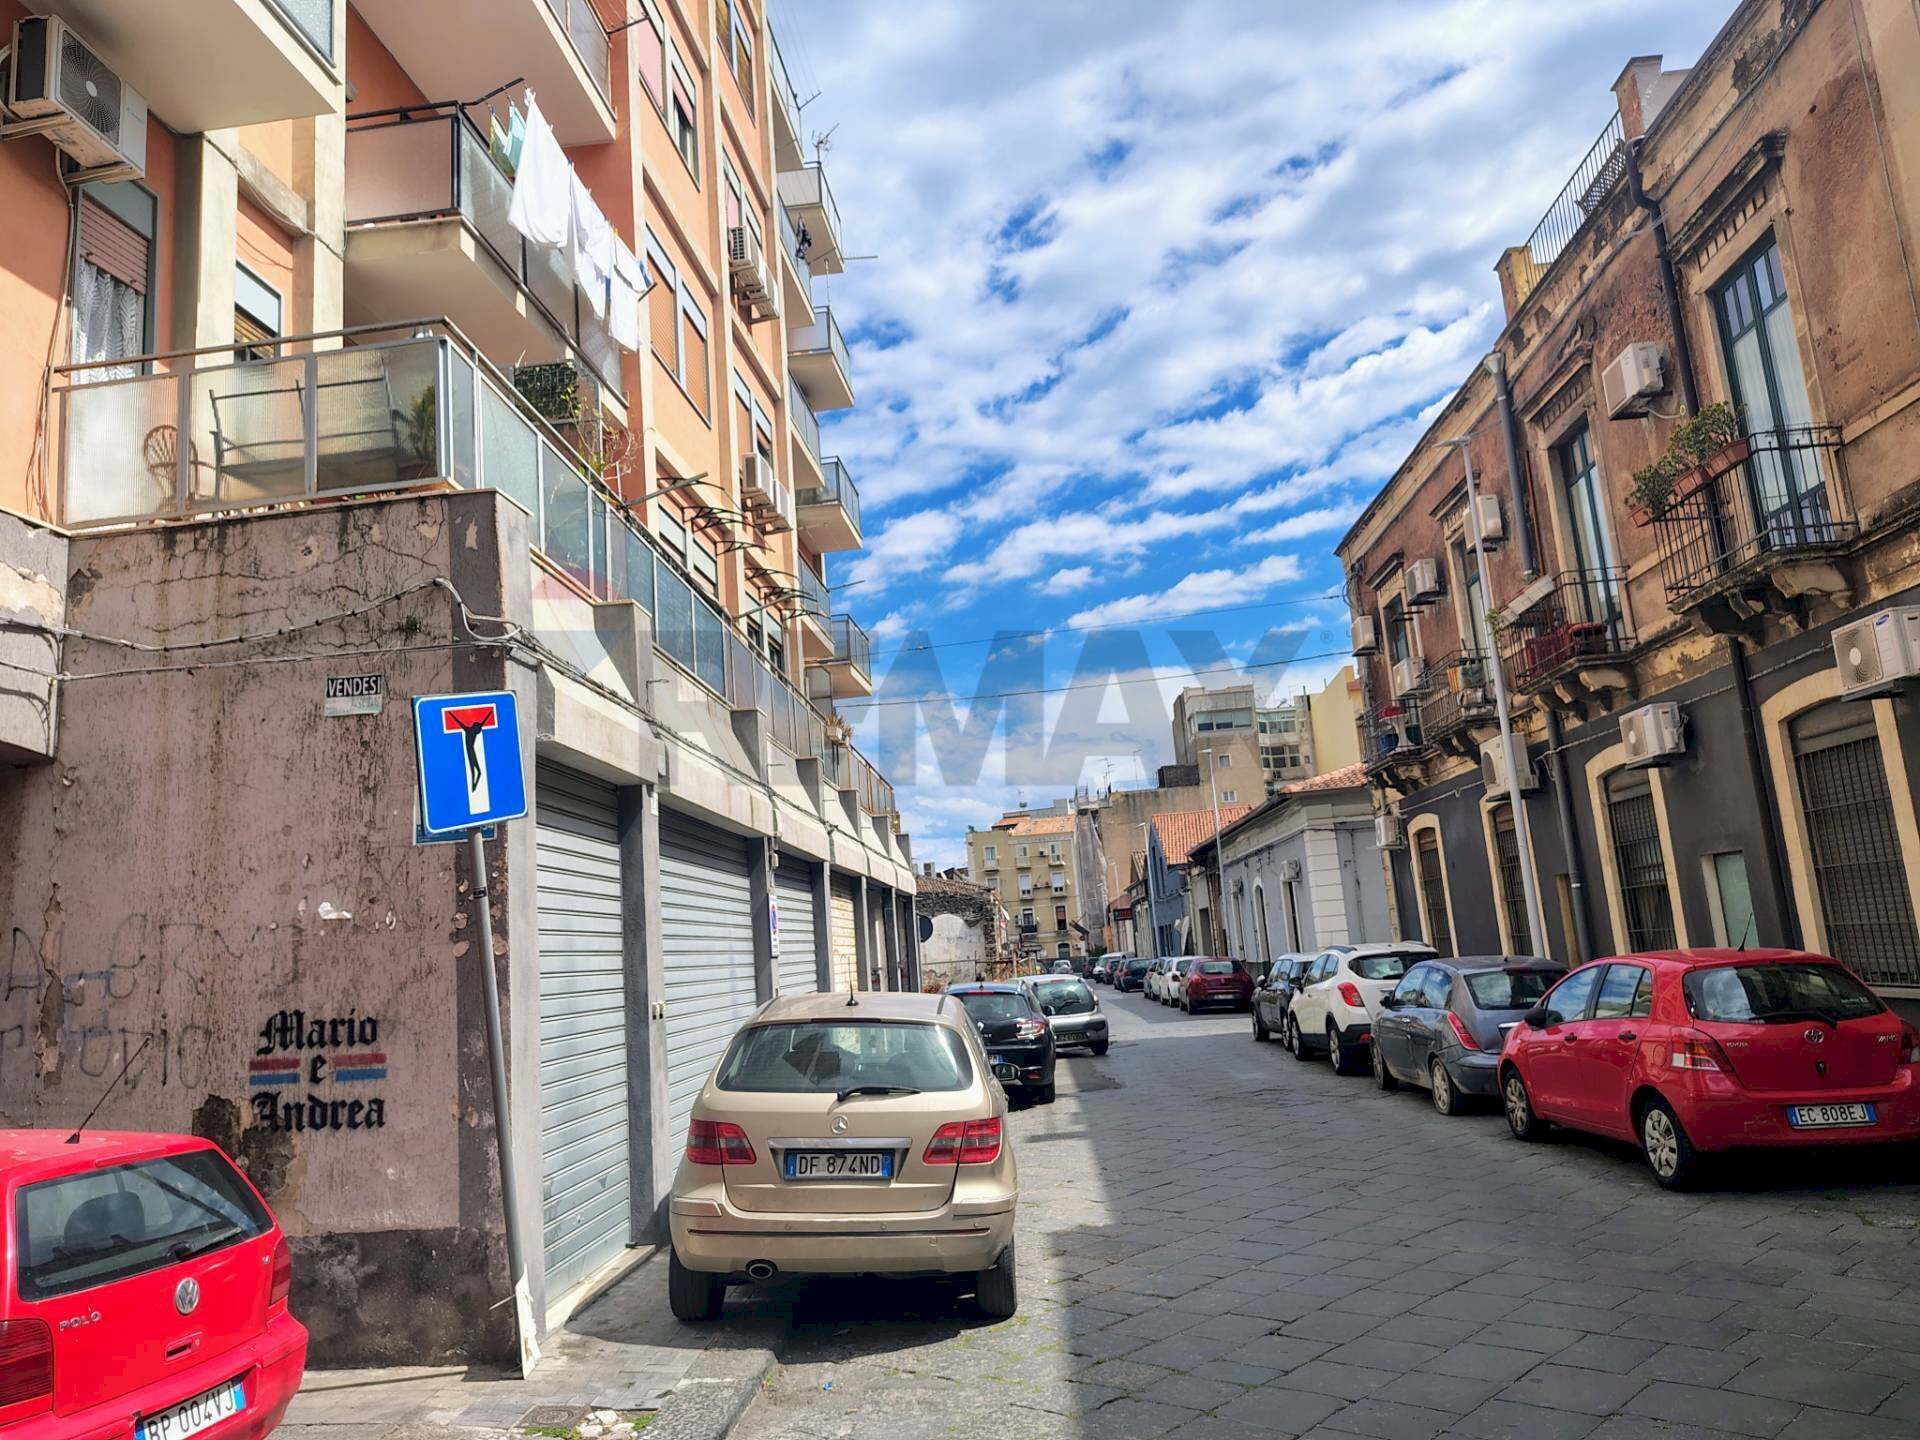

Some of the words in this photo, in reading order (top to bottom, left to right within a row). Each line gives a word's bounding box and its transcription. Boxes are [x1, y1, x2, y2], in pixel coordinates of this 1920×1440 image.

[328, 676, 381, 697] VENDESI
[256, 1007, 379, 1056] Mario
[309, 1054, 328, 1084] e
[251, 1091, 386, 1132] Andrea
[1798, 1107, 1817, 1123] EC
[1820, 1103, 1867, 1122] 808EJ
[798, 1155, 820, 1175] DF
[826, 1155, 881, 1175] 874ND
[59, 1310, 102, 1332] POLO
[147, 1414, 172, 1440] BP
[178, 1384, 234, 1433] 004VJ
